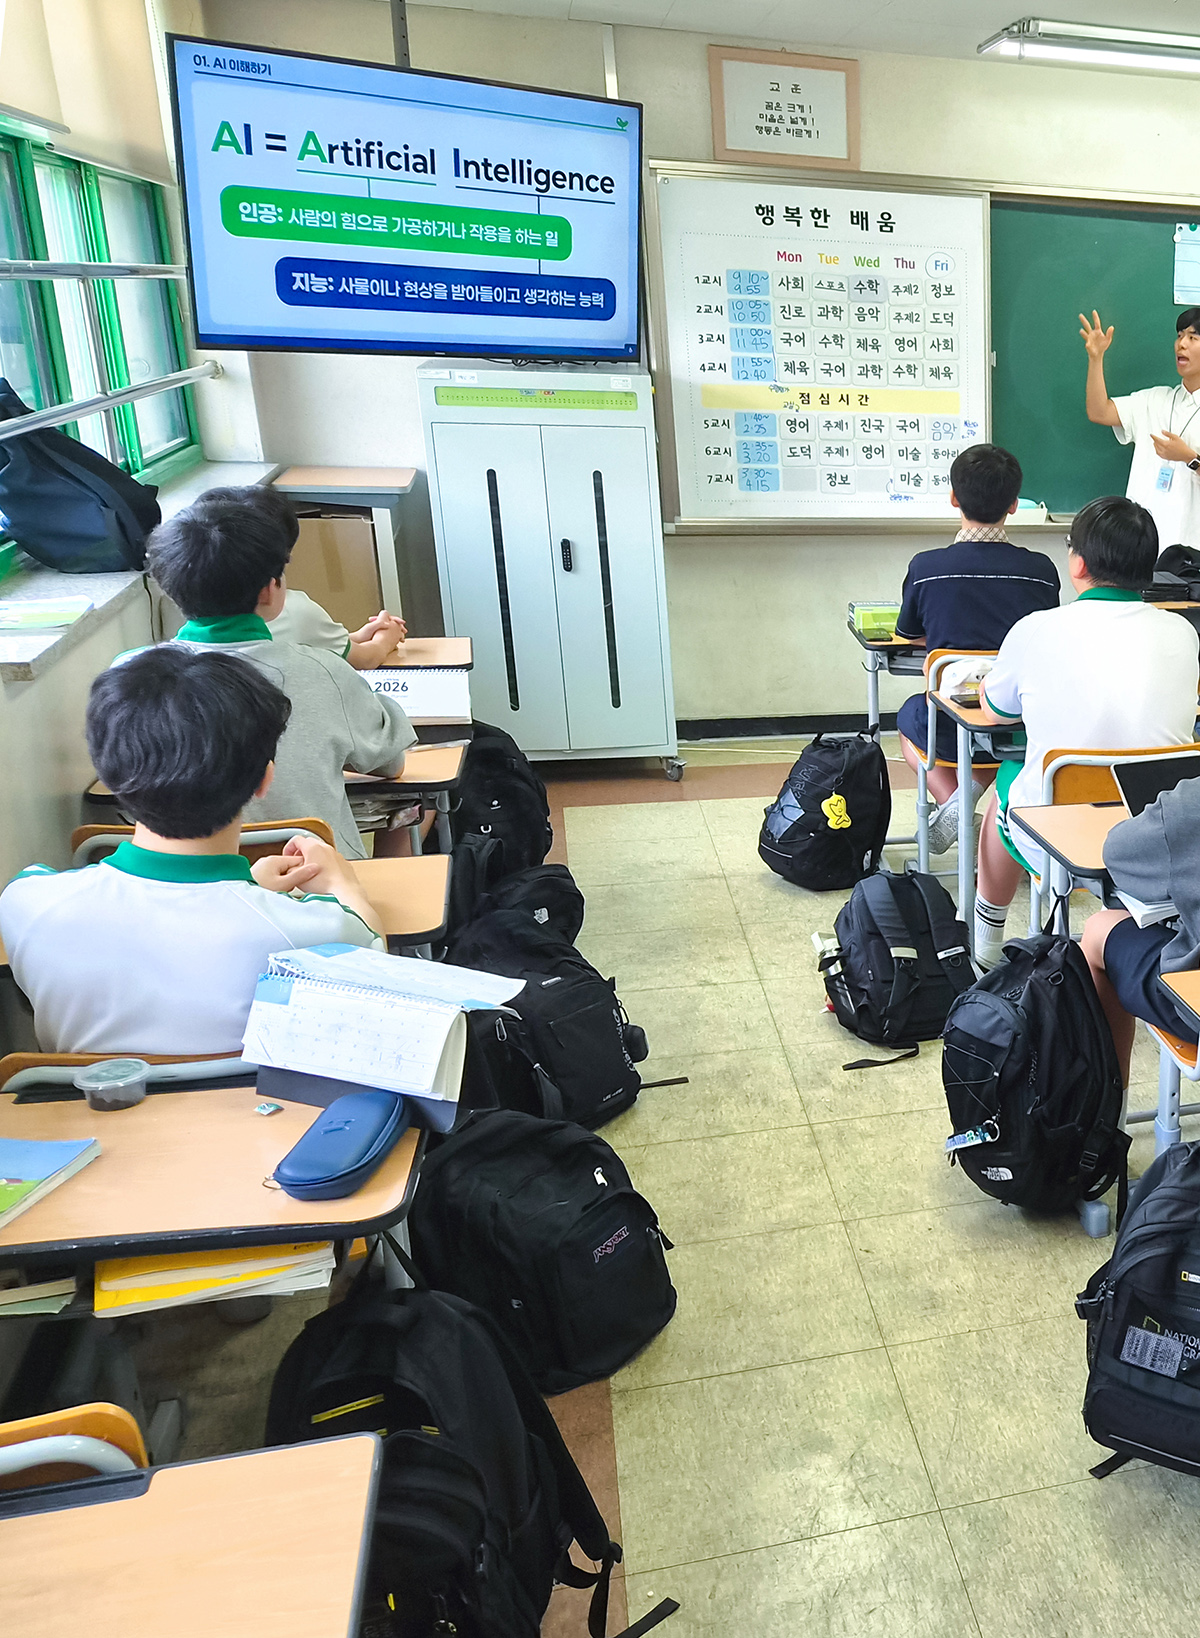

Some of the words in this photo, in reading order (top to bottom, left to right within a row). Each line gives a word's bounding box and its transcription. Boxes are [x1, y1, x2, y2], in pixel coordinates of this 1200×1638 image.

[193, 54, 211, 68] 01.
[213, 57, 226, 70] AI
[229, 59, 271, 76] 이해하기
[211, 120, 254, 156] AI
[264, 132, 288, 152] =
[297, 130, 437, 175] Artificial
[453, 148, 616, 194] Intelligence
[238, 201, 284, 224] 인공:
[288, 208, 337, 228] 사람의
[340, 211, 389, 232] 힘으로
[391, 216, 467, 240] 가공하거나
[469, 223, 512, 244] 작용을
[515, 228, 542, 246] 하는
[545, 231, 559, 247] 일
[755, 203, 831, 229] 행복한
[849, 209, 897, 234] 배움
[776, 250, 803, 263] Mon
[817, 252, 840, 265] Tue
[853, 255, 881, 268] Wed
[893, 256, 916, 270] Thu
[934, 259, 949, 272] Fri
[694, 275, 722, 287] 1교시
[777, 275, 804, 292] 사회
[814, 279, 847, 293] 스포츠
[853, 278, 881, 296] 수학
[291, 271, 334, 293] 지능:
[338, 277, 402, 297] 사물이나
[403, 280, 448, 300] 현상을
[451, 284, 521, 304] 받아들이고
[523, 288, 576, 307] 생각하는
[579, 292, 604, 309] 능력
[891, 283, 920, 297] 주제2
[930, 282, 956, 299] 정보
[696, 304, 723, 316] 2교시
[779, 305, 806, 321] 진로
[816, 304, 844, 322] 과학
[854, 305, 881, 323] 음악
[892, 311, 921, 324] 주제2
[929, 312, 955, 327] 도덕
[697, 333, 725, 345] 3교시
[779, 331, 806, 348] 국어
[818, 333, 846, 350] 수학
[855, 337, 883, 354] 체육
[894, 336, 918, 353] 영어
[929, 337, 954, 353] 사회
[699, 362, 727, 374] 4교시
[783, 359, 810, 377] 체육
[820, 362, 846, 378] 국어
[856, 363, 884, 380] 과학
[892, 363, 919, 379] 수학
[928, 365, 954, 381] 체육
[799, 392, 870, 406] 점심시간
[703, 418, 730, 430] 5교시
[785, 417, 810, 434] 영어
[822, 419, 849, 432] 주제1
[860, 417, 885, 434] 진국
[896, 418, 920, 434] 국어
[931, 420, 958, 441] 음악
[704, 446, 732, 458] 6교시
[786, 444, 812, 460] 도덕
[822, 445, 849, 458] 주제1
[861, 444, 885, 460] 영어
[897, 446, 922, 461] 미술
[706, 474, 734, 485] 7교시
[826, 471, 851, 487] 정보
[900, 471, 924, 487] 미술
[374, 681, 409, 693] 2026
